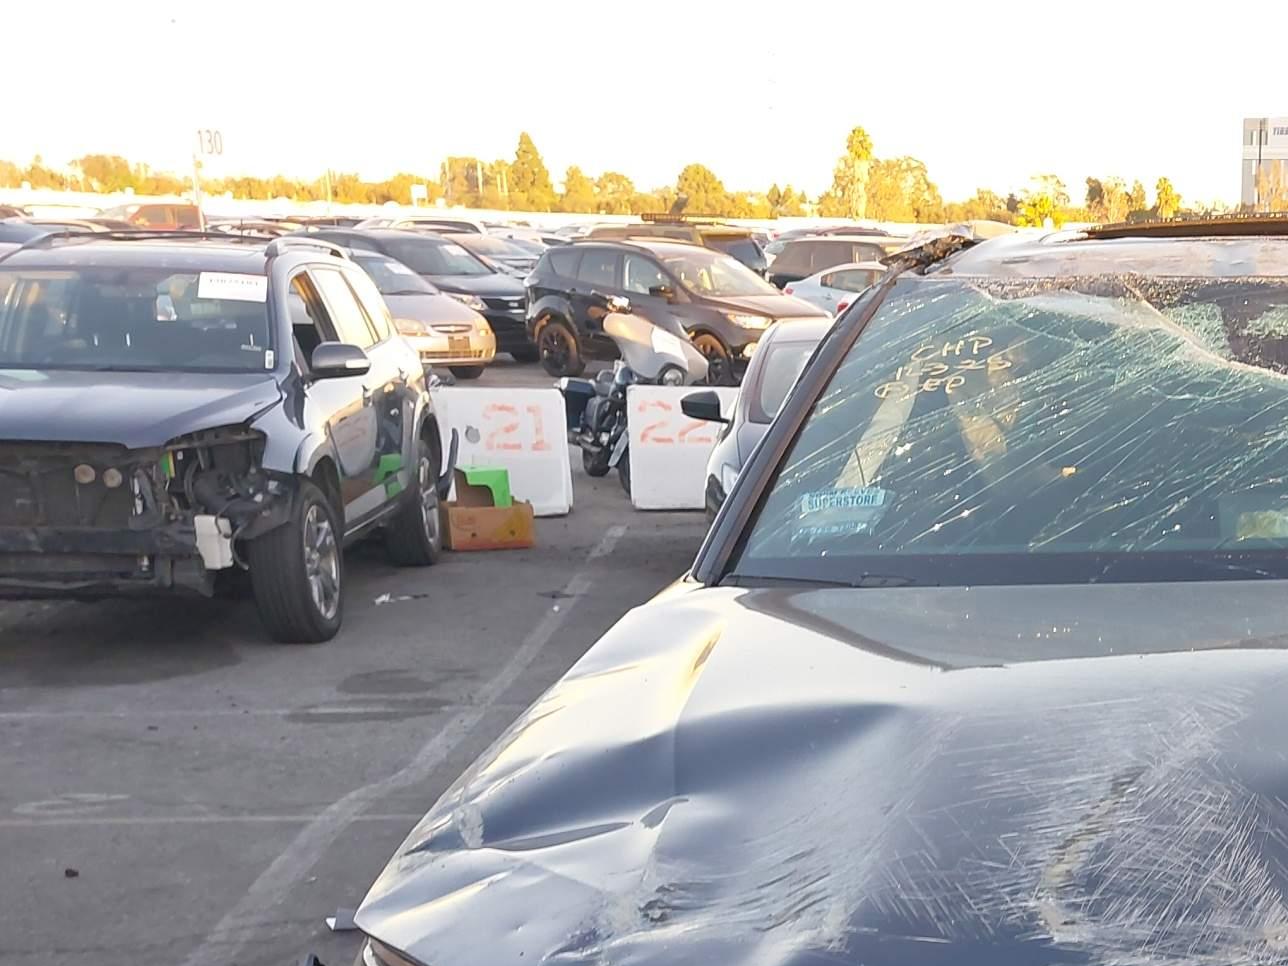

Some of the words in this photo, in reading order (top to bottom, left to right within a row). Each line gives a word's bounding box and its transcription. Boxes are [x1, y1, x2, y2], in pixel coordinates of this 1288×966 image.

[198, 129, 223, 156] 130
[911, 336, 993, 361] CHP
[482, 403, 551, 451] 21
